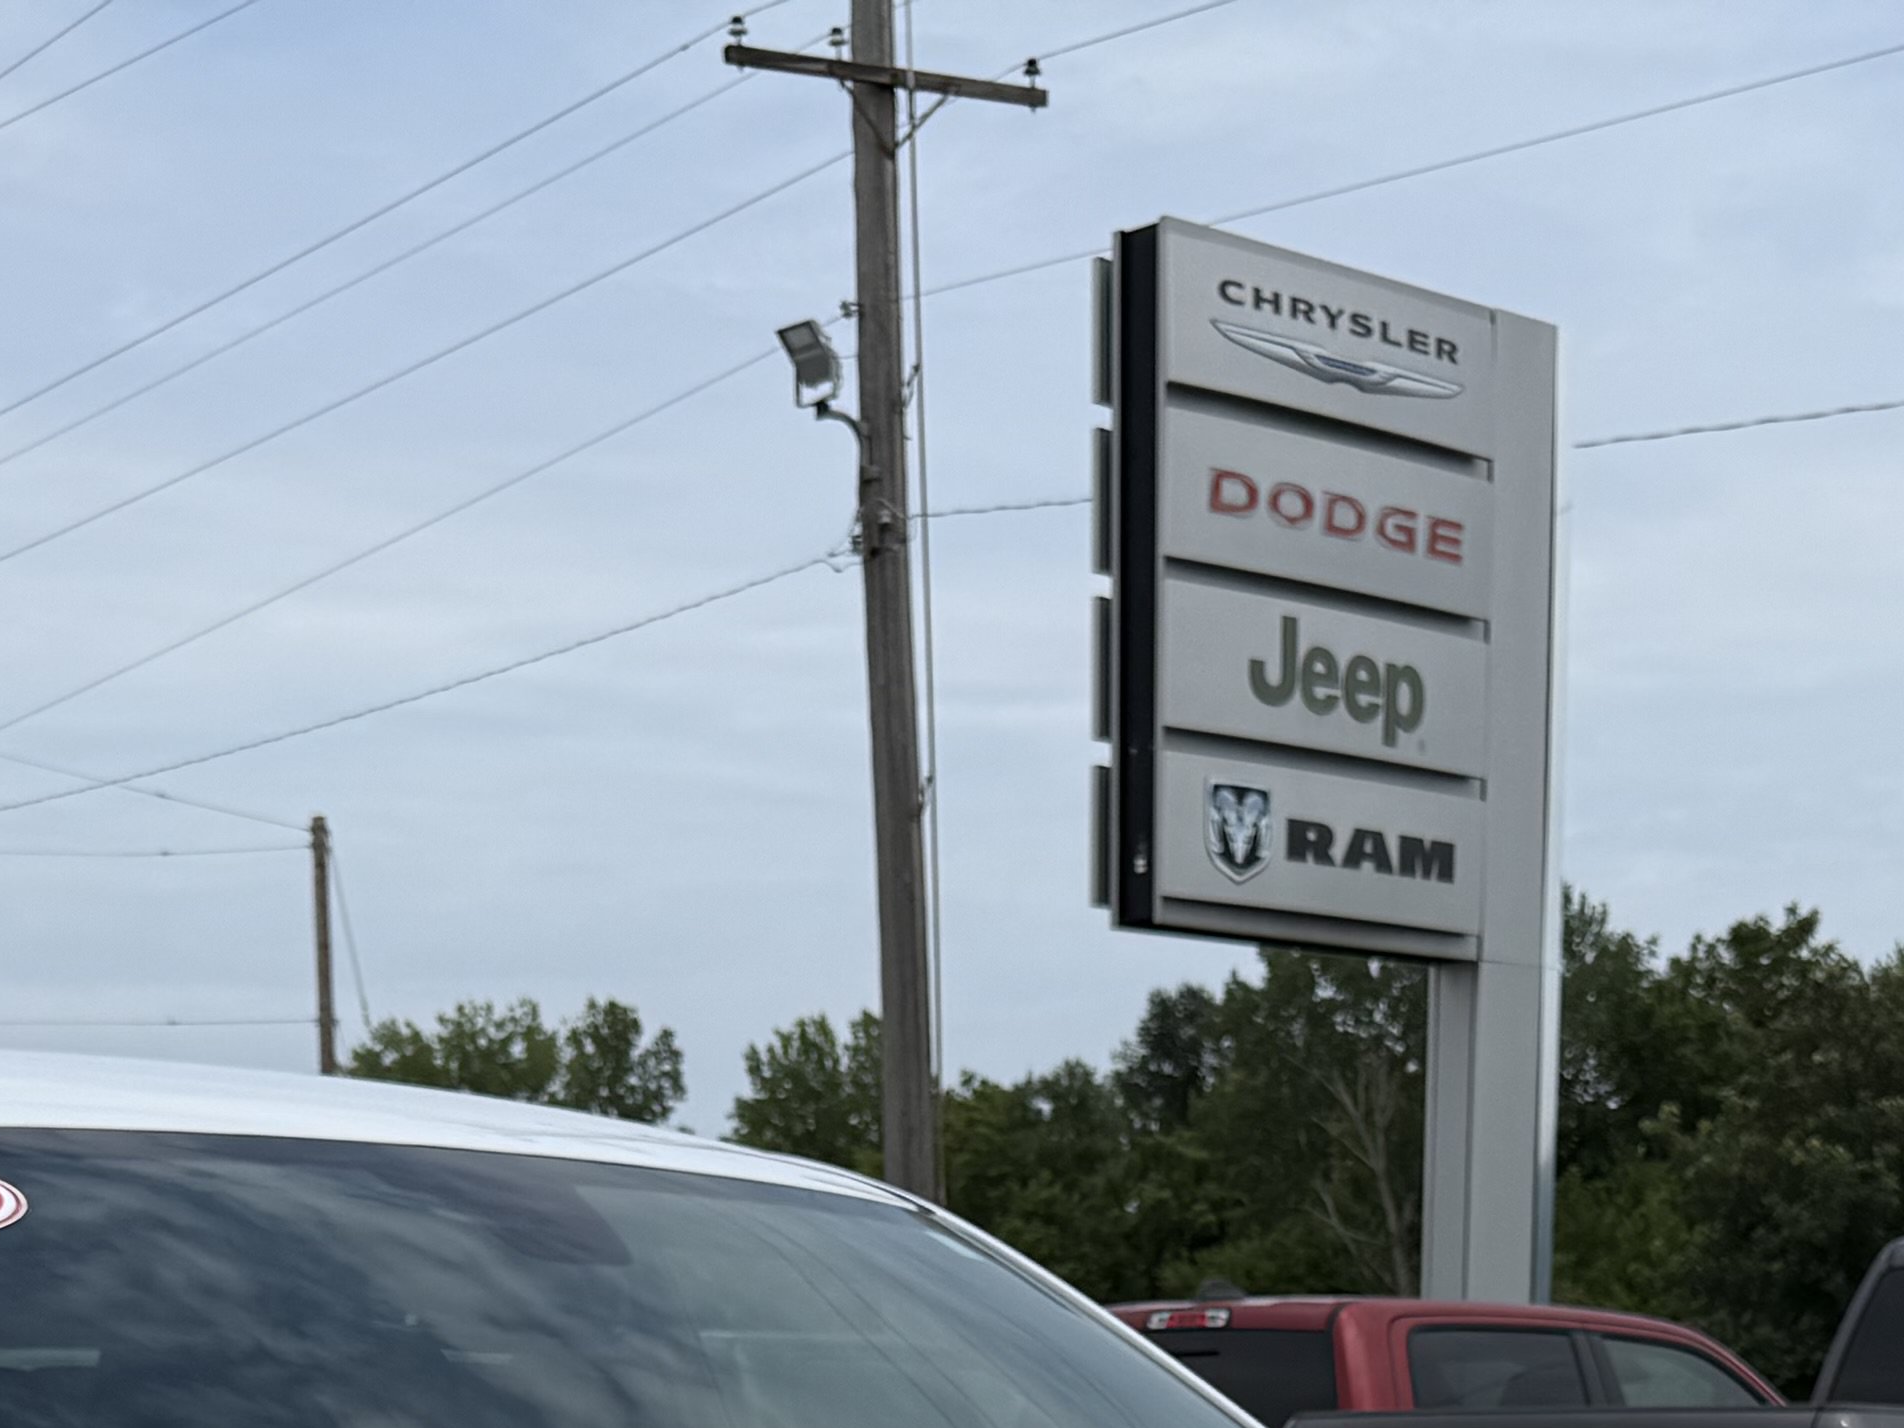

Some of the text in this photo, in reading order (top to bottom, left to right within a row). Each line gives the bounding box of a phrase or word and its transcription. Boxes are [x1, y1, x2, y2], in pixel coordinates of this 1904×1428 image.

[1218, 277, 1460, 366] CHRYSLER
[1207, 466, 1465, 565] DODGE
[1248, 616, 1425, 747] Jeep
[1286, 817, 1456, 884] RAM
